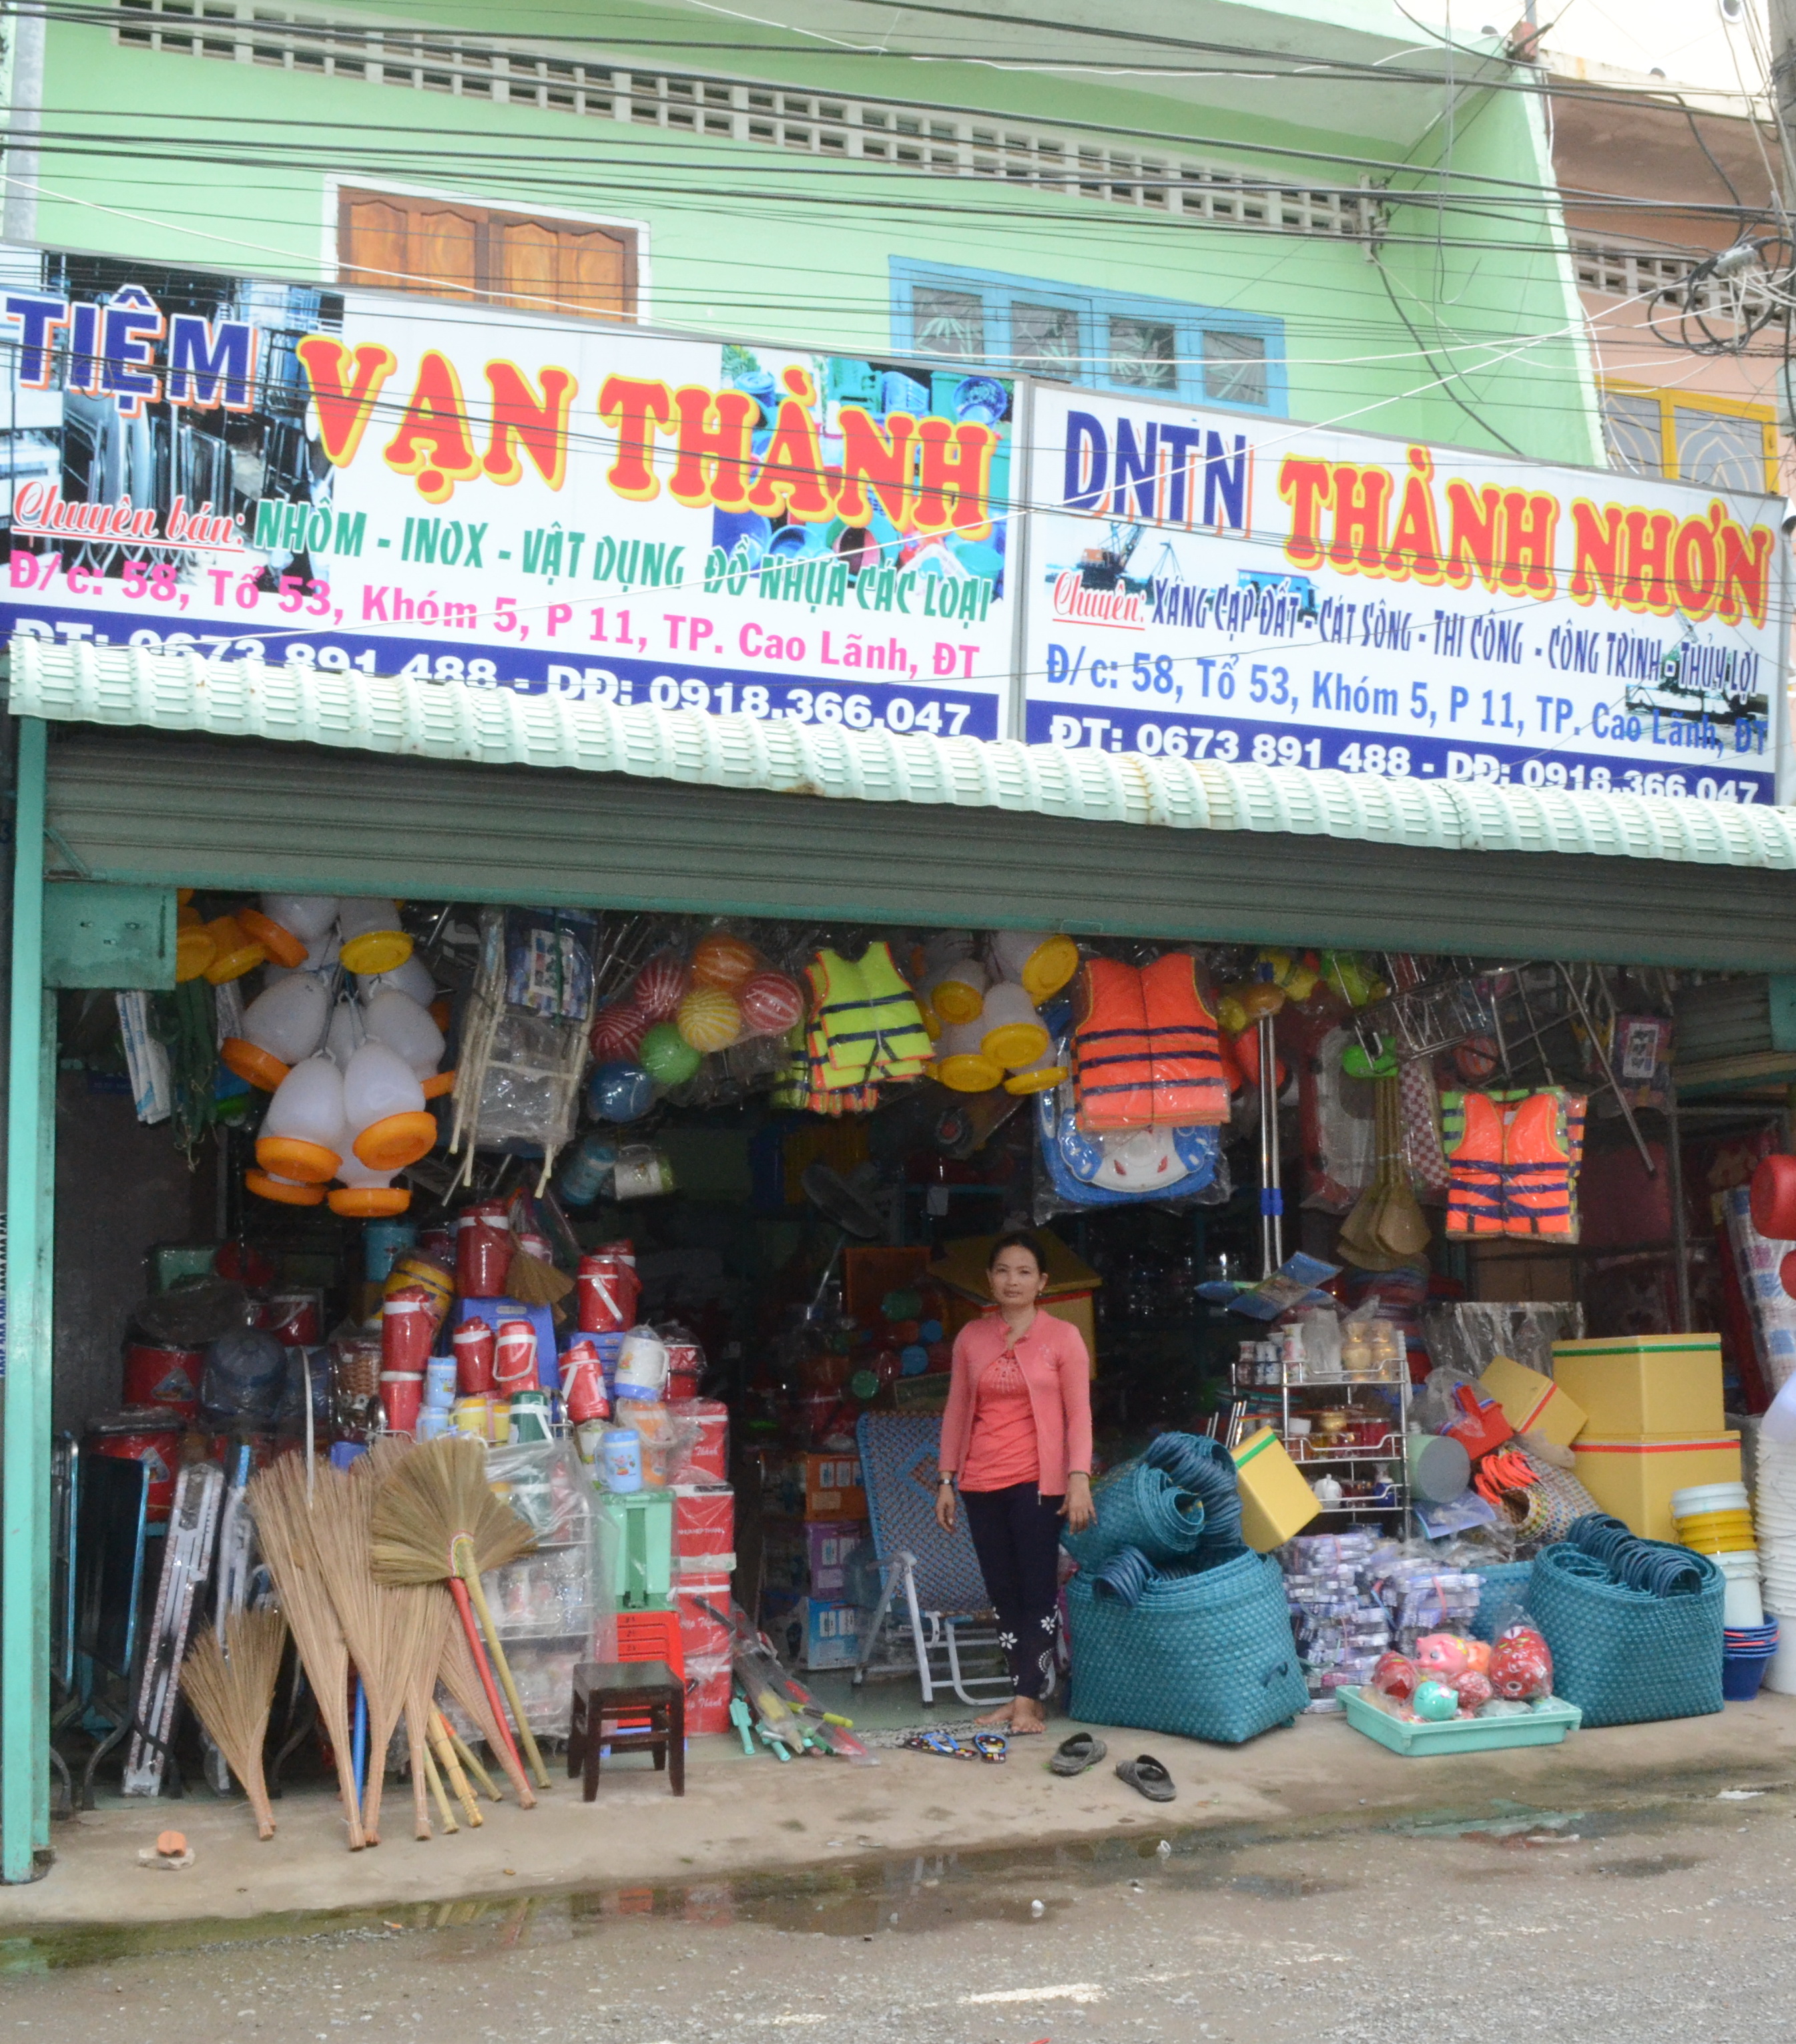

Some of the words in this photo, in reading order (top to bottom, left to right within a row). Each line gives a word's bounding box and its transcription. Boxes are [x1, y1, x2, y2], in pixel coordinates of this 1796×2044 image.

[5, 284, 258, 418] TIỆM
[296, 334, 578, 504] VẠN
[597, 366, 997, 540] THÀNH
[1064, 410, 1255, 539] DNTN
[13, 481, 158, 537] Chuyên
[166, 495, 245, 545] bán:
[255, 497, 367, 557] NHÔM
[401, 517, 489, 568] INOX
[523, 521, 585, 585] VẬT
[593, 535, 686, 592] DỤNG
[704, 534, 751, 596] ĐỒ
[760, 554, 850, 613] NHỰA
[856, 559, 916, 613] CÁC
[924, 571, 993, 629] LOẠI
[1277, 443, 1560, 602] THÀNH
[1569, 498, 1774, 629] NHƠN
[121, 561, 190, 611] 58,
[208, 565, 264, 609] Tổ
[278, 575, 343, 625] 53,
[362, 585, 478, 629] Khóm
[493, 597, 529, 641] 5,
[547, 602, 573, 637] P
[589, 607, 647, 653] 11,
[663, 614, 723, 654] TP.
[739, 622, 806, 662] Cao
[821, 630, 918, 680] Lãnh,
[932, 642, 980, 678] ĐT
[1053, 571, 1147, 622] Chuyên:
[1215, 584, 1254, 641] CẠP
[1259, 579, 1300, 638] ĐẤT
[1319, 595, 1356, 645] CÁT
[1361, 599, 1412, 652] SÔNG
[1434, 609, 1465, 658] THI
[1470, 608, 1524, 664] CÔNG
[1548, 618, 1600, 674] CÔNG
[1606, 628, 1662, 682] TRÌNH
[1681, 633, 1727, 689] THỦY
[1731, 647, 1759, 700] LỢI
[284, 643, 376, 676] 891
[400, 654, 497, 689] 488
[547, 664, 633, 706] DĐ:
[649, 676, 971, 735] 0918.366.047
[1133, 652, 1183, 704] 58,
[1197, 654, 1239, 700] Tổ
[1249, 664, 1298, 714] 53,
[1312, 670, 1398, 716] Khóm
[1410, 681, 1437, 728] 5,
[1450, 685, 1469, 722] P
[1482, 690, 1524, 737] 11,
[1536, 695, 1580, 736] TP.
[1592, 702, 1642, 742] Cao
[1652, 708, 1724, 758] Lãnh,
[1735, 717, 1768, 755] ĐT
[1049, 714, 1123, 752] ĐT:
[1137, 723, 1239, 762] 0673
[1251, 733, 1321, 768] 891
[1337, 742, 1411, 776] 488
[1446, 750, 1510, 785] DĐ:
[1522, 760, 1759, 804] 0918.366.047
